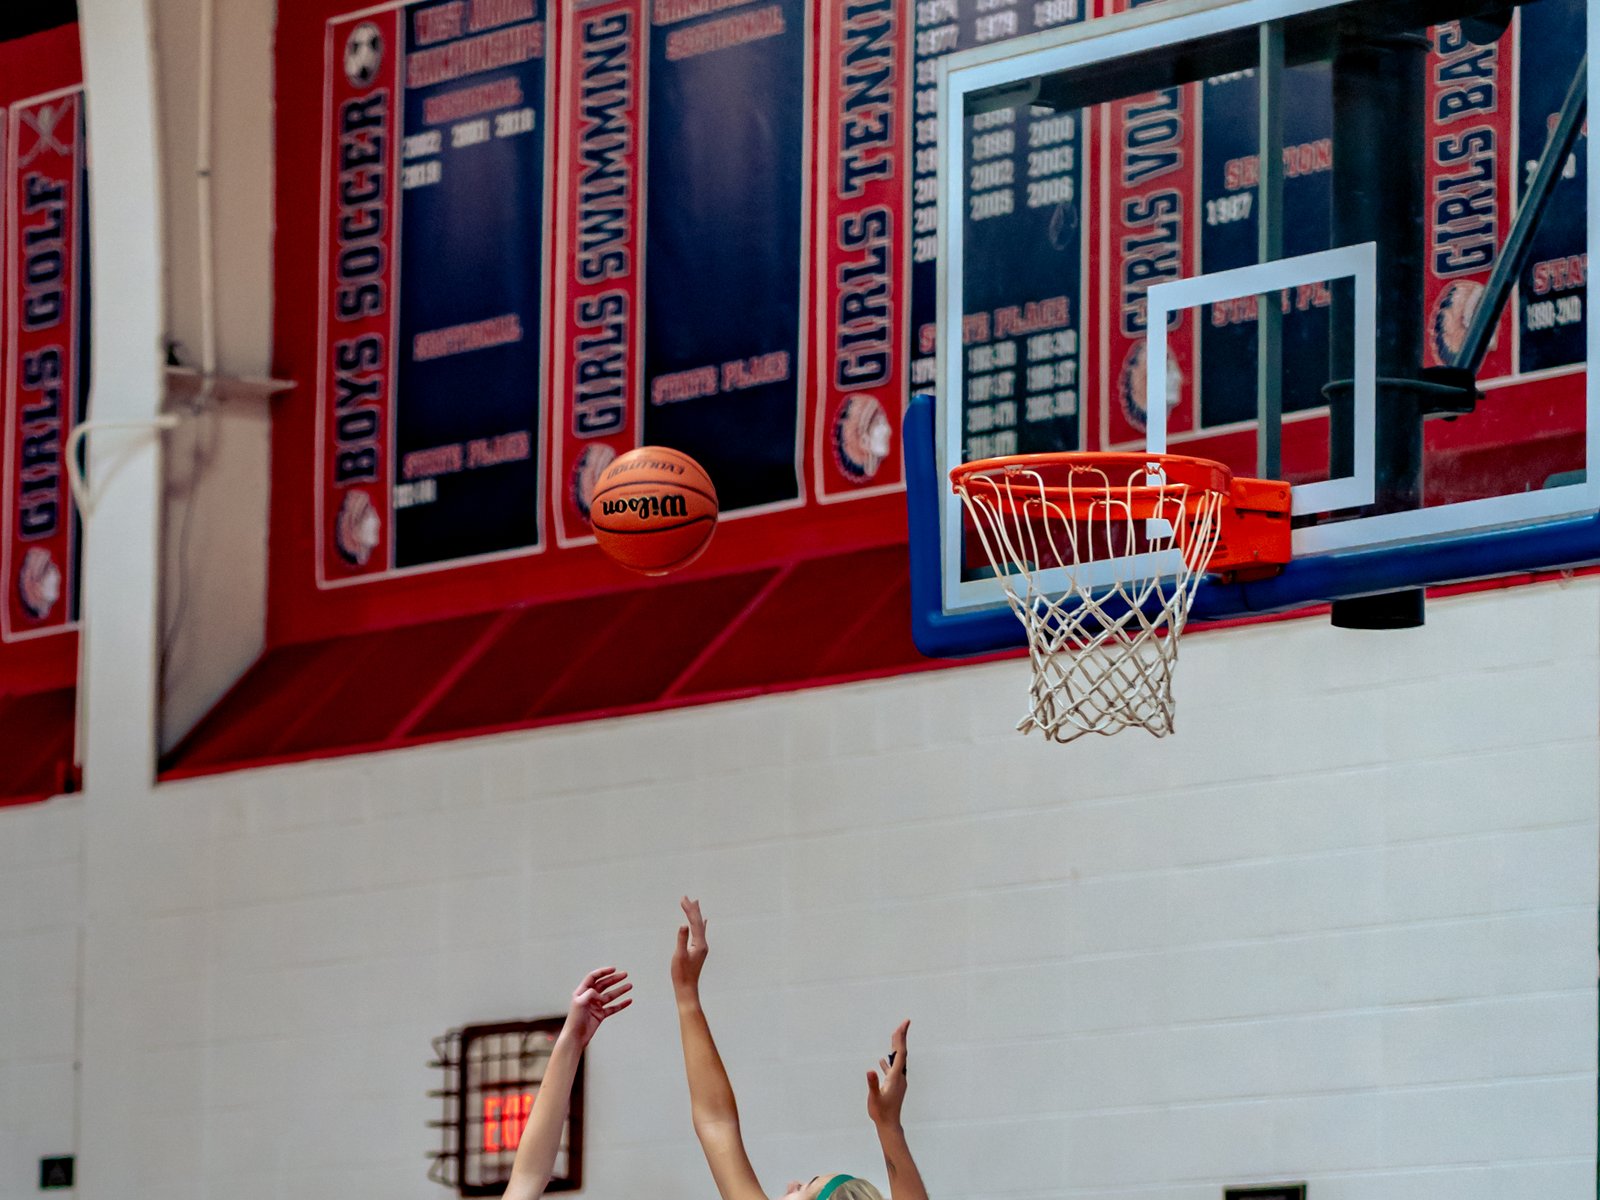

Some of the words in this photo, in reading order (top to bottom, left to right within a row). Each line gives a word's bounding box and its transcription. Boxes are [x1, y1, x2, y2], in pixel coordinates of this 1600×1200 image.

[336, 87, 389, 322] SOCCER
[574, 10, 634, 286] SWIMMING
[1223, 138, 1333, 190] SEION
[1431, 124, 1498, 279] GIRLS
[22, 171, 67, 332] GOLF
[834, 205, 895, 392] GIRLS
[334, 332, 385, 487] BOYS
[572, 289, 630, 439] GIRLS
[20, 345, 64, 542] GIRLS
[602, 494, 688, 520] Wilson
